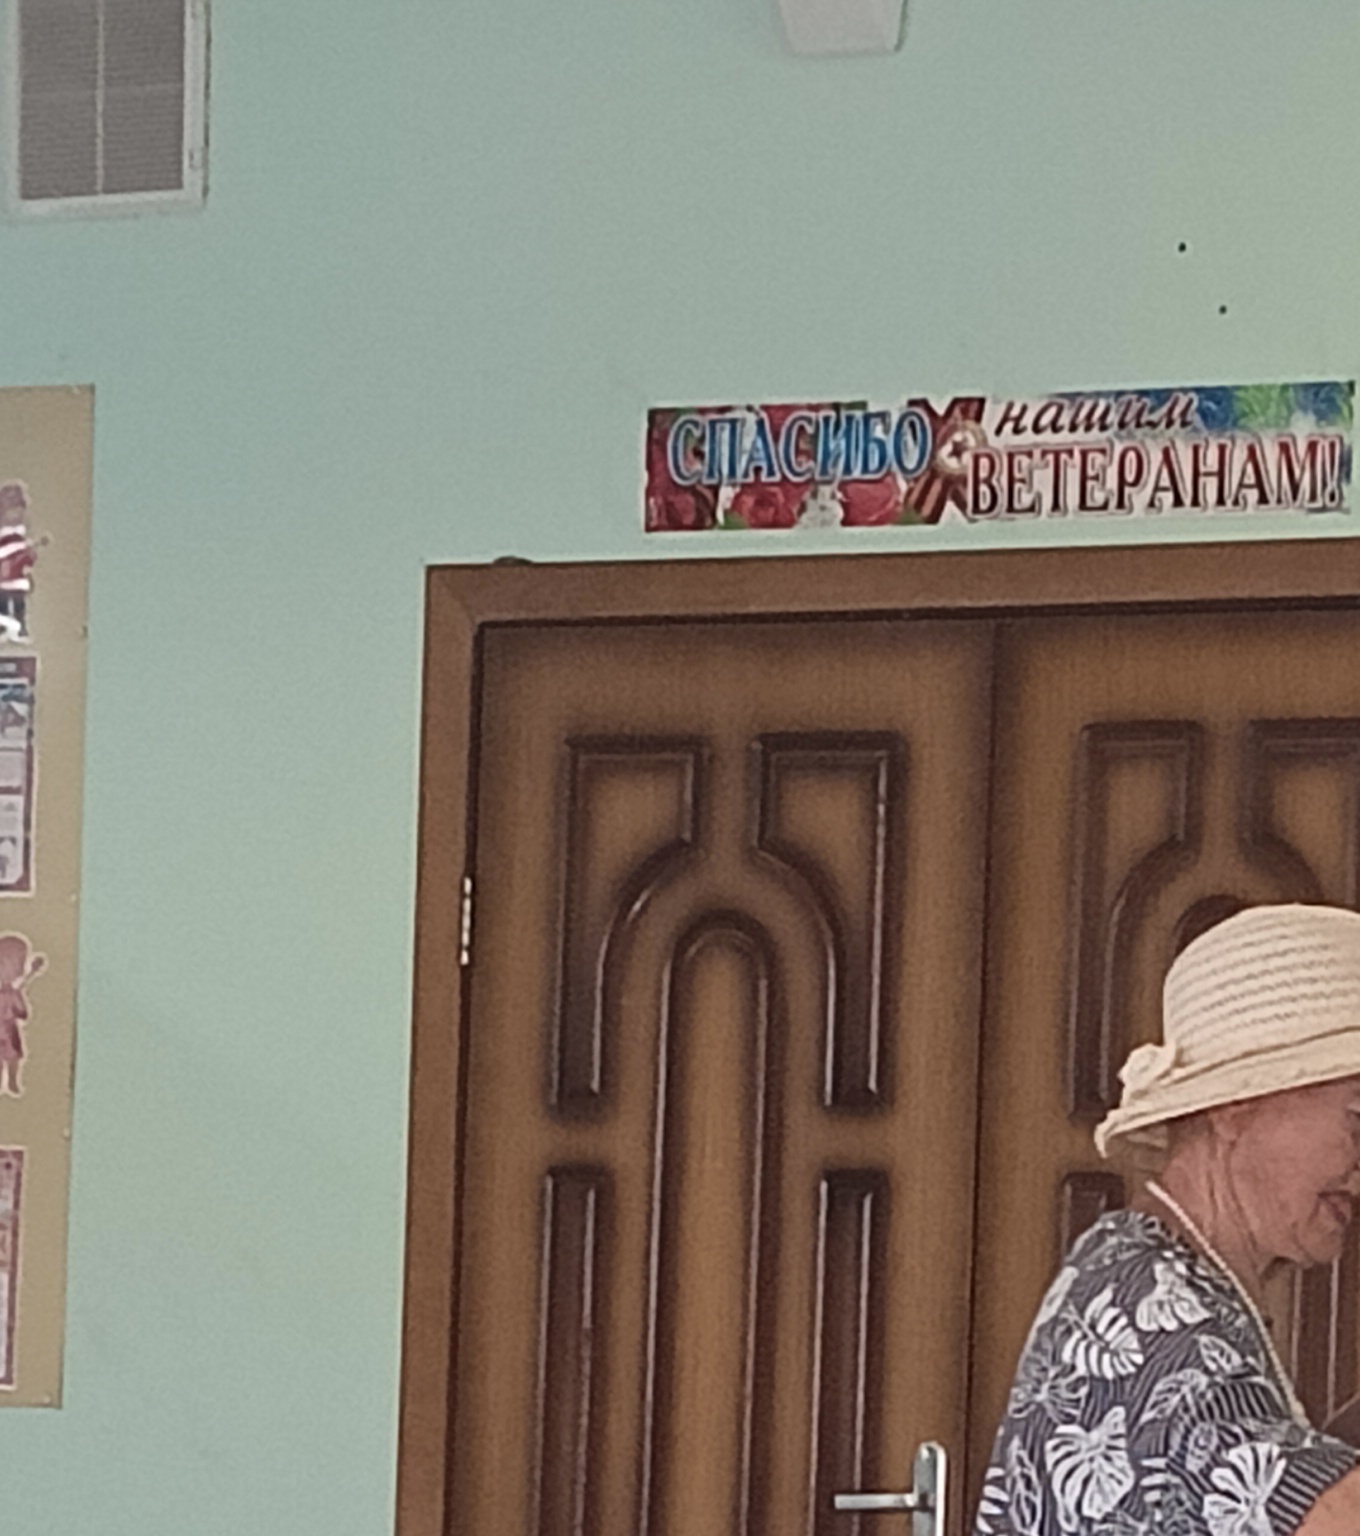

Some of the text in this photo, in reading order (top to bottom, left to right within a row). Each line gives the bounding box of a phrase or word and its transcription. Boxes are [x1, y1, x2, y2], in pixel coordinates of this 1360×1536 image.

[667, 408, 934, 487] СПАСИБО
[994, 393, 1200, 438] нашим
[970, 434, 1342, 520] ВЕТЕРАНАМ!
